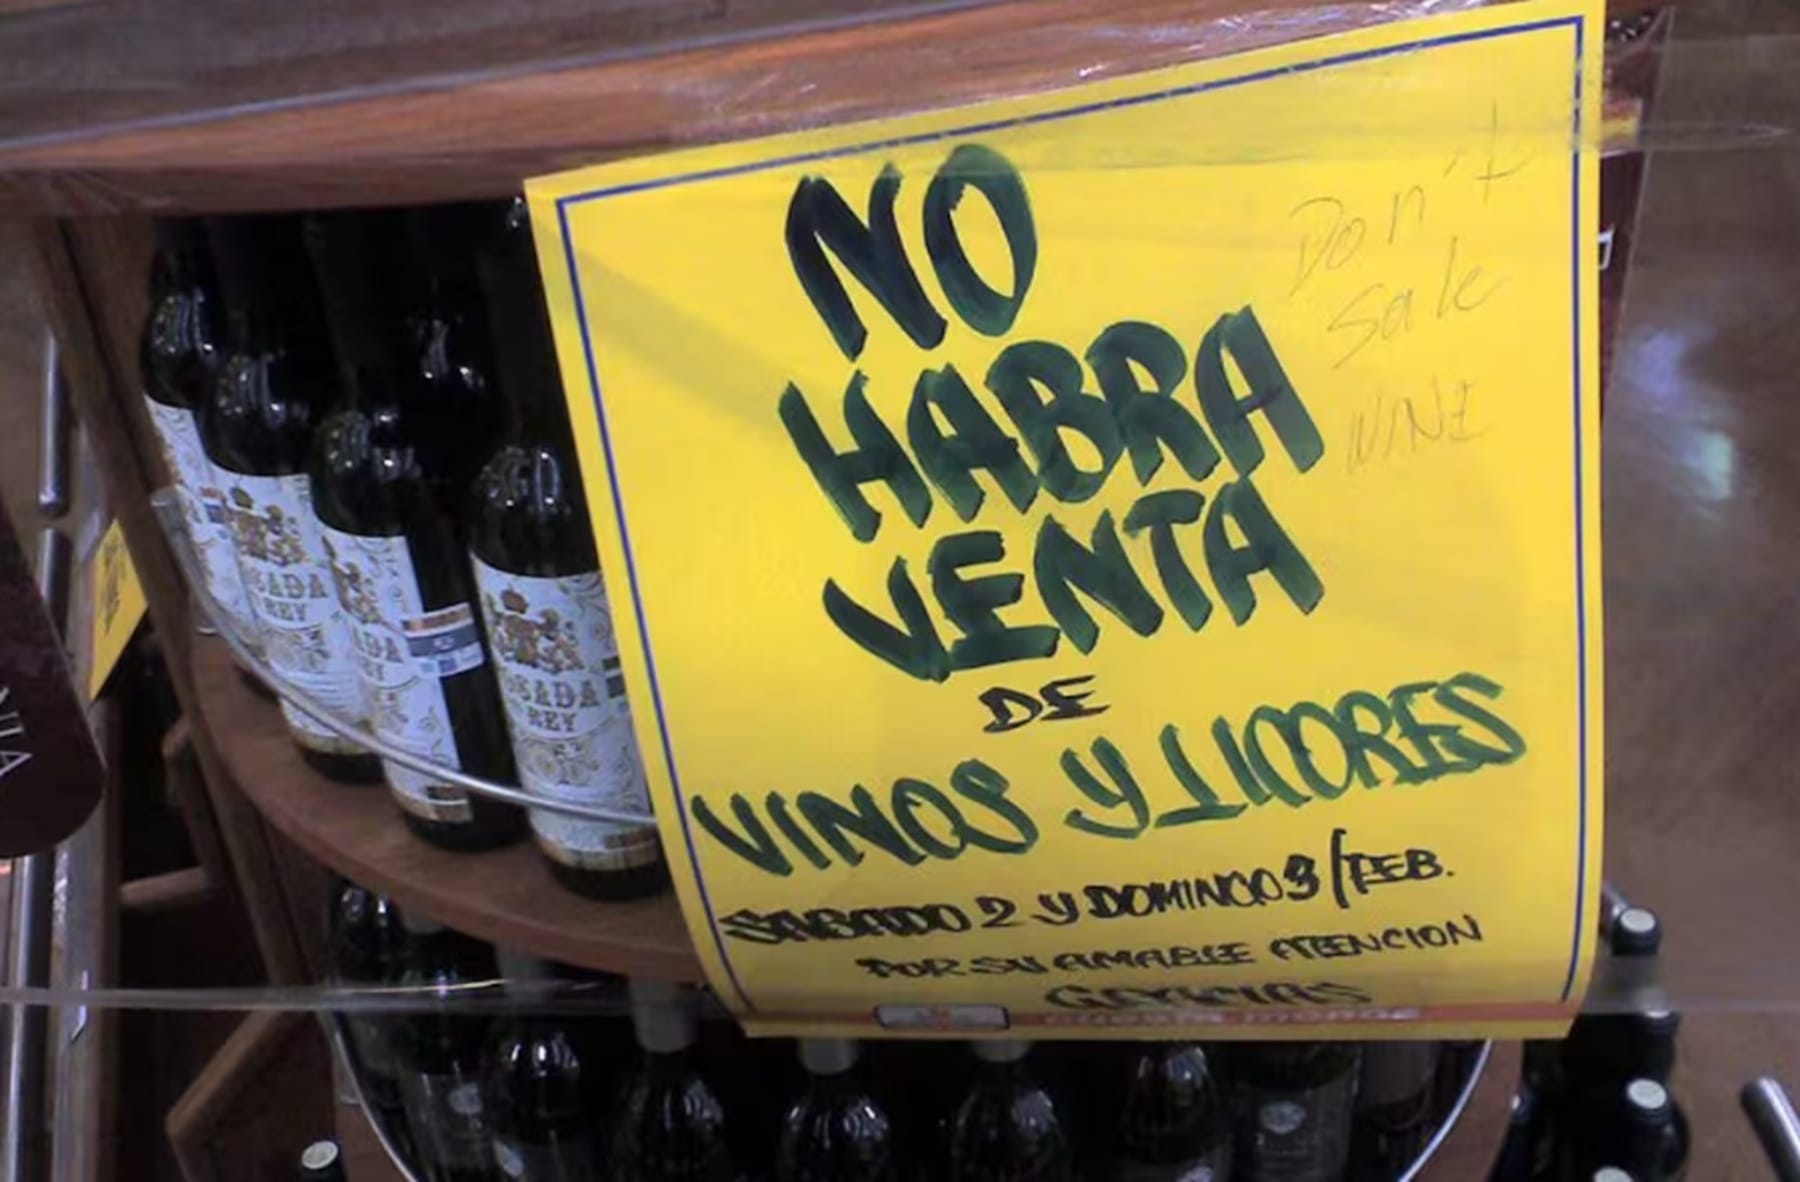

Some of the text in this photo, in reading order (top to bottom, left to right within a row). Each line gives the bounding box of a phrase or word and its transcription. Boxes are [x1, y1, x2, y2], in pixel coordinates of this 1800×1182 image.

[785, 143, 1038, 362] NO
[778, 305, 1325, 543] HABRA
[822, 478, 1325, 683] VENTA
[691, 671, 1526, 877] VINOS Y LICORES
[978, 675, 1111, 733] DE
[975, 896, 1025, 929] 2
